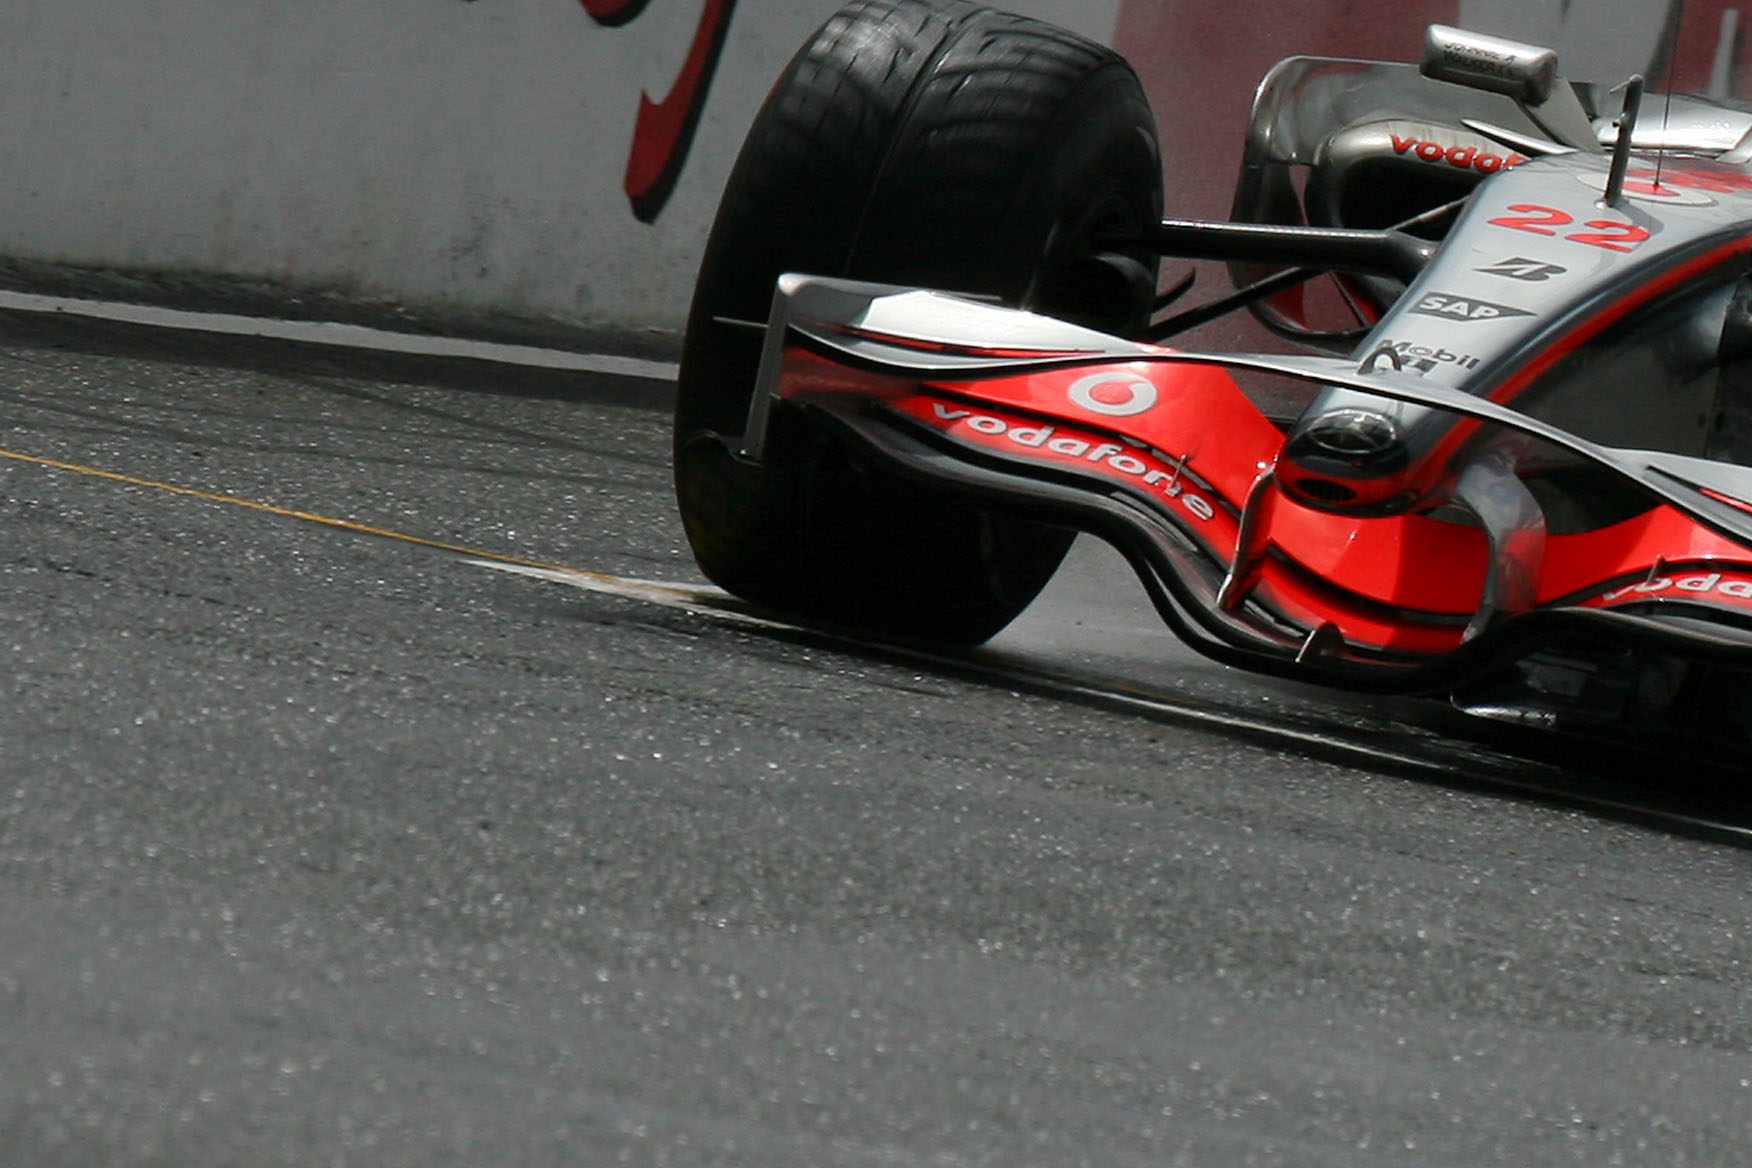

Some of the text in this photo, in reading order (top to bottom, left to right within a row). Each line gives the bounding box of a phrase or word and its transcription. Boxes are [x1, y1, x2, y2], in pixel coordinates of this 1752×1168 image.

[1487, 203, 1651, 253] 22
[1418, 295, 1500, 319] SAP
[1375, 338, 1481, 371] Mobil
[931, 402, 1215, 521] vodafone
